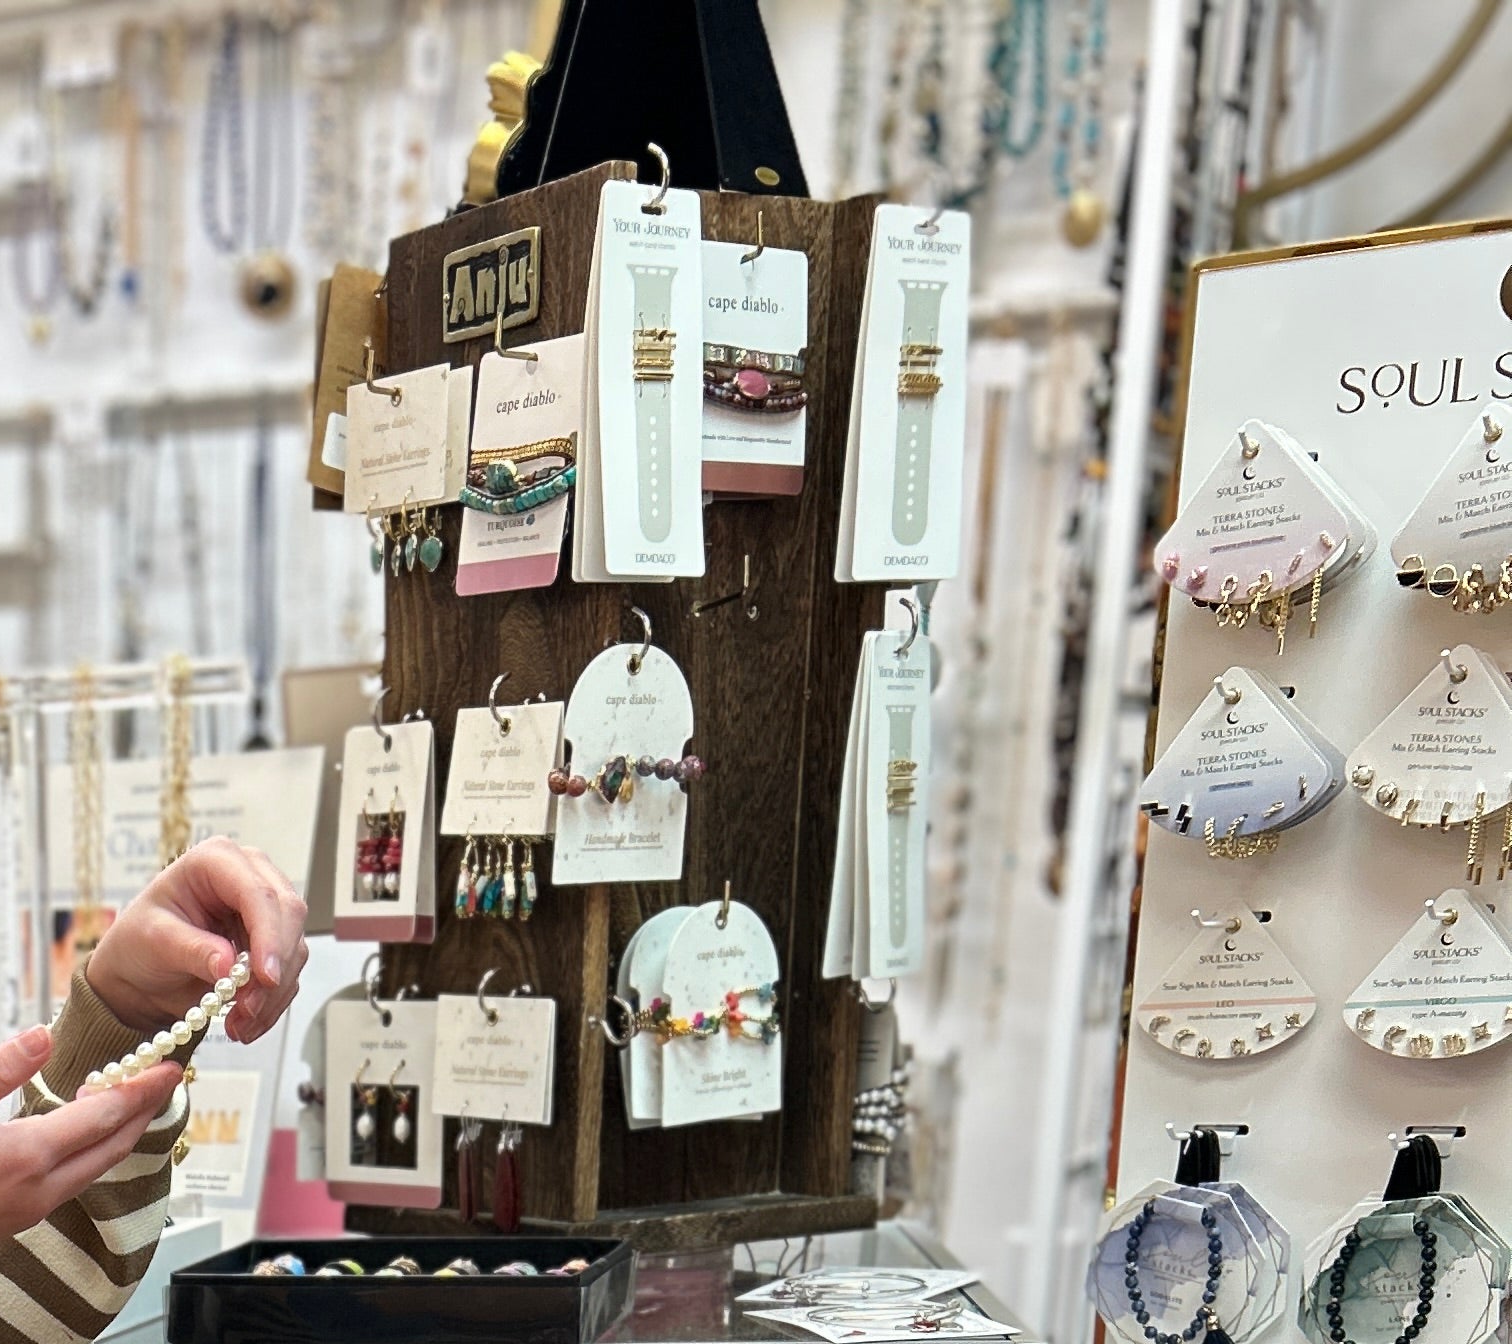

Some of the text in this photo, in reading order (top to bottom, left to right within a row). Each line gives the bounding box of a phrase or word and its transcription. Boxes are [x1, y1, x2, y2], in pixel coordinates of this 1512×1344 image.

[612, 218, 691, 239] YOUR JOURNEY
[887, 235, 963, 254] YOUR JOURNEY
[449, 244, 530, 323] Anju
[708, 295, 779, 314] cape diablo
[1337, 357, 1479, 414] SOUL
[496, 390, 556, 415] cape diablo
[1458, 469, 1484, 484] SOUL
[1216, 485, 1240, 499] SOUL
[1455, 496, 1487, 510] TERRA
[1213, 504, 1285, 525] TERRA STONES
[606, 693, 657, 710] cape diablo
[1418, 706, 1443, 717] SOUL
[1200, 729, 1225, 741] SOUL
[1411, 733, 1482, 744] TERRA STONES
[1197, 748, 1267, 766] TERRA STONES
[1199, 955, 1223, 965] SOUL
[1413, 949, 1437, 960] SOUL
